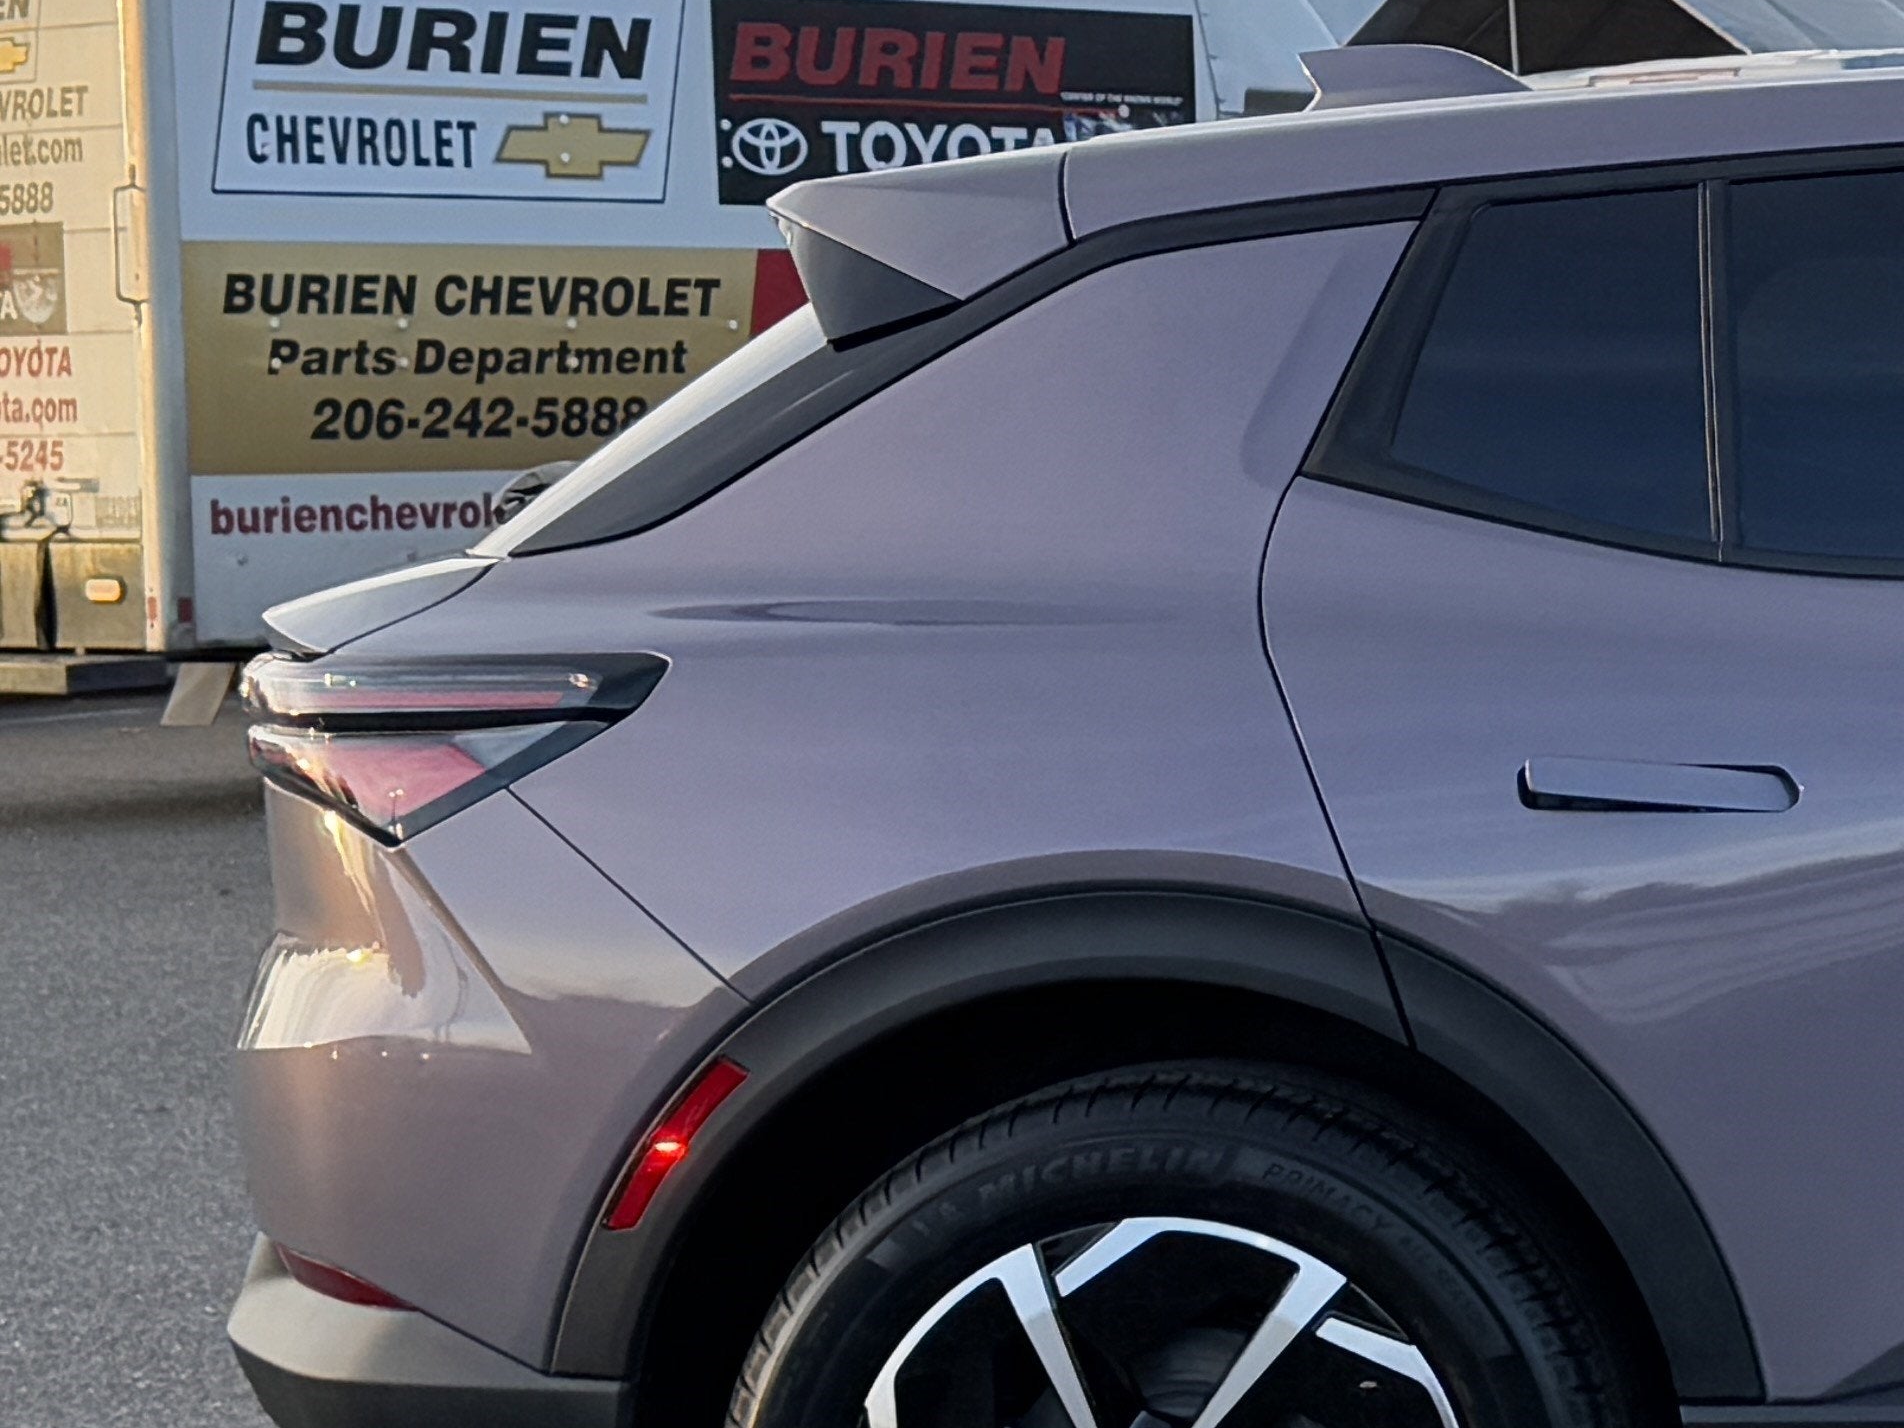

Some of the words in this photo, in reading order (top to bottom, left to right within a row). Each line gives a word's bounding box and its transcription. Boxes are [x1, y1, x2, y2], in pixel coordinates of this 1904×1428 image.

[255, 0, 652, 80] BURIEN
[729, 21, 1066, 95] BURIEN
[0, 85, 88, 121] VROLET
[246, 113, 477, 168] CHEVROLET
[0, 181, 53, 215] 5888
[223, 273, 417, 314] BURIEN
[435, 275, 721, 316] CHEVROLET
[0, 346, 72, 378] OYOTA
[267, 339, 397, 375] Parts
[415, 339, 688, 384] Department
[310, 396, 648, 441] 206-242-5888
[210, 492, 493, 535] burienchevrol
[977, 1144, 1226, 1198] MICHELIN
